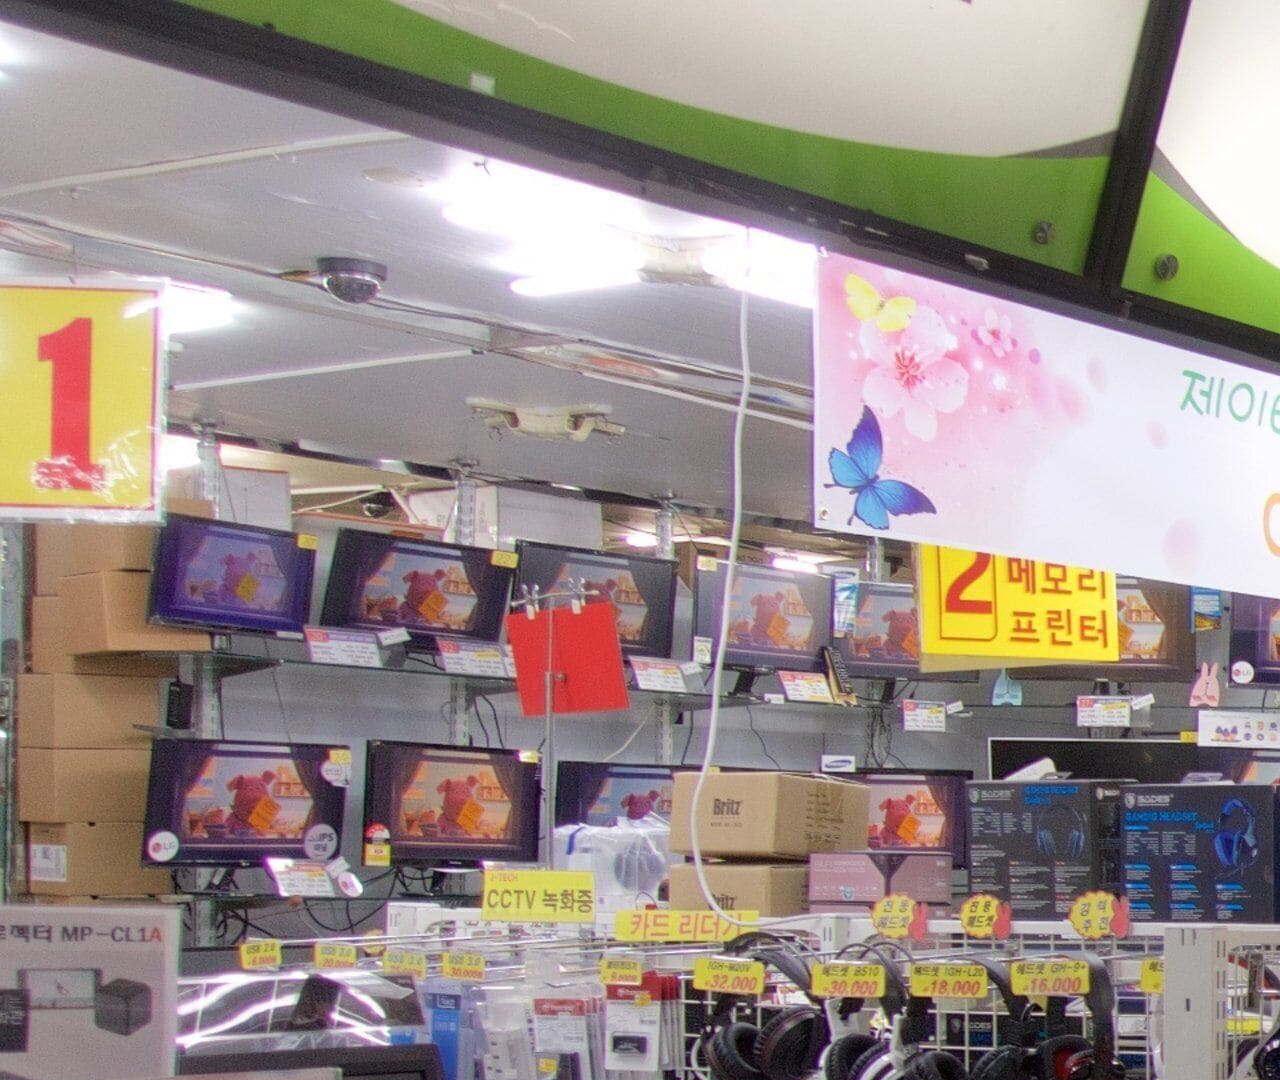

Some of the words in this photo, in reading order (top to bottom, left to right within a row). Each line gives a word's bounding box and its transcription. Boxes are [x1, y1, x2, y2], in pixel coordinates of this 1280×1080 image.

[37, 316, 106, 491] 1
[1008, 552, 1109, 599] 메모리
[1010, 609, 1109, 649] 프린터
[713, 796, 741, 816] Britz
[1135, 795, 1169, 807] SADES
[1125, 811, 1160, 823] GAMING
[1161, 811, 1197, 823] HEADSET
[487, 888, 536, 909] CCTV
[542, 889, 593, 913] 녹화중
[631, 913, 670, 936] 카드
[679, 913, 743, 939] 리더기
